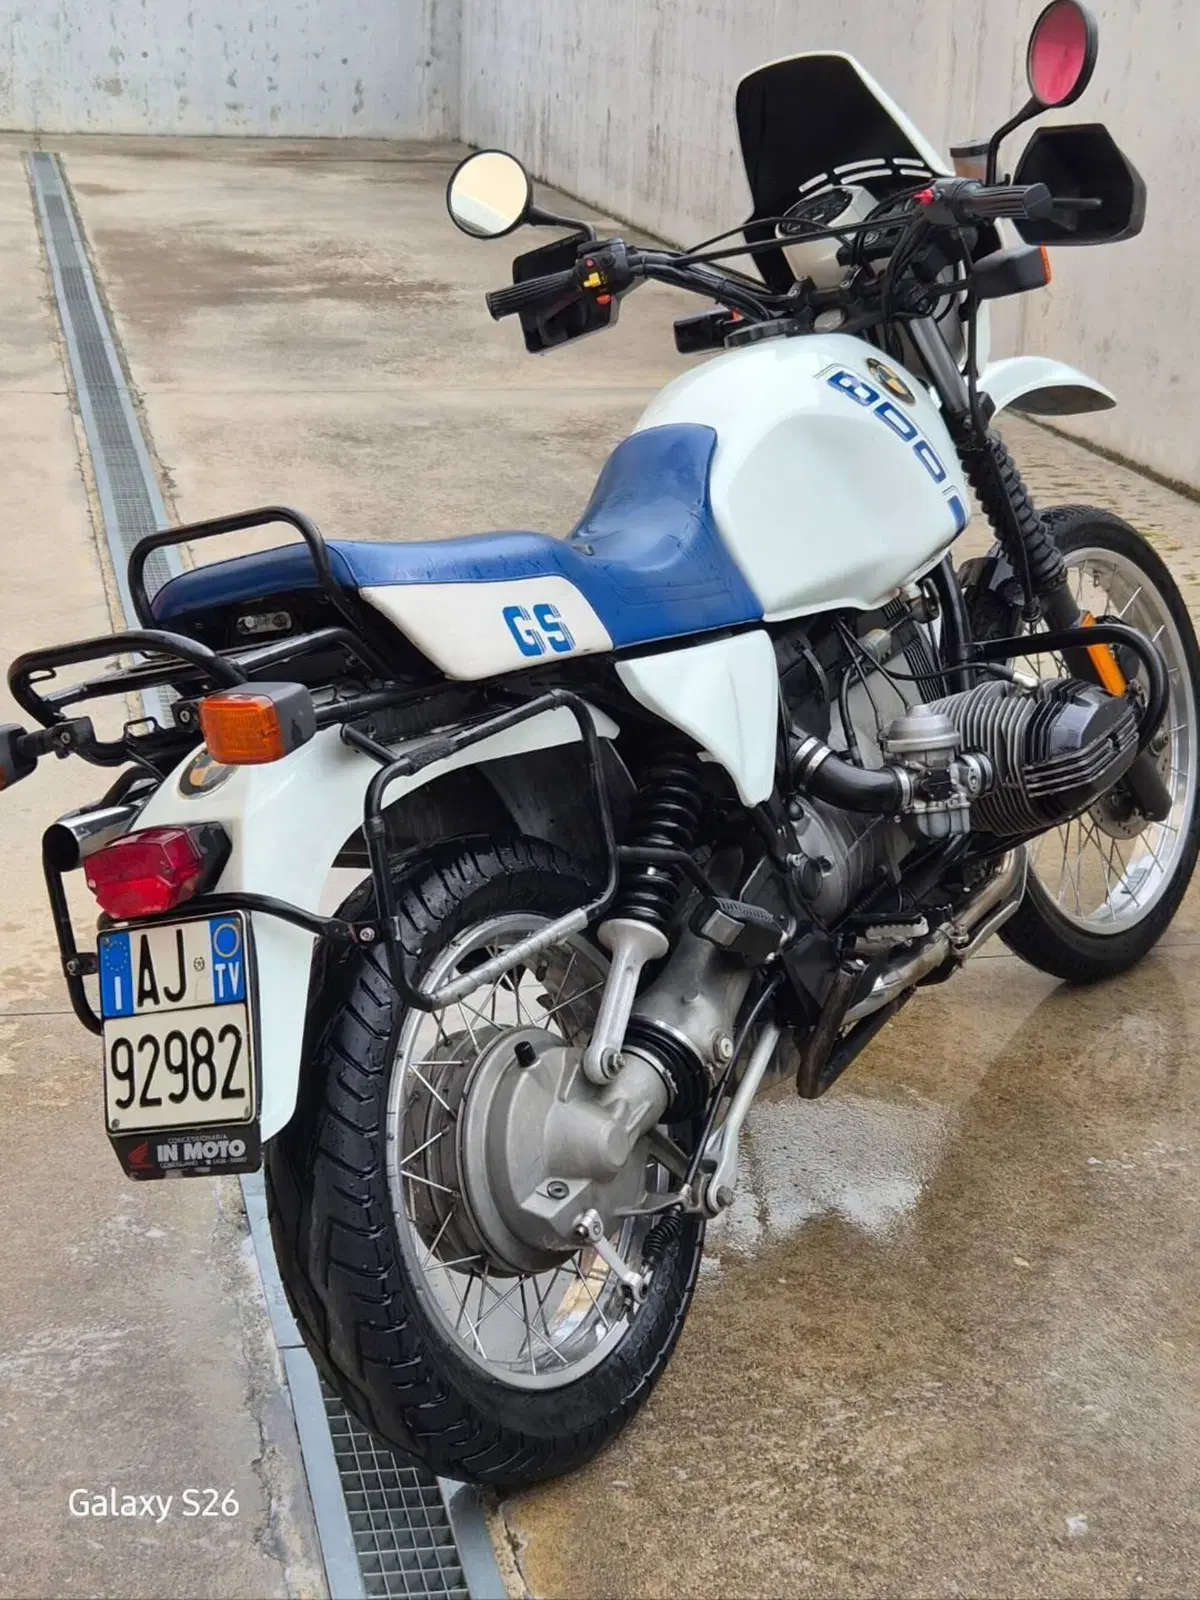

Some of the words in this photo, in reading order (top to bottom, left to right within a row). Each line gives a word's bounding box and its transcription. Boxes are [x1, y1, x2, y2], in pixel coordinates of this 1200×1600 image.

[827, 370, 947, 484] 800
[502, 603, 576, 657] GS
[137, 928, 187, 1007] AJ
[214, 961, 240, 998] TV
[111, 1024, 245, 1109] 92982
[157, 1144, 178, 1162] IN
[184, 1139, 246, 1160] MOTO
[167, 1133, 228, 1144] CONCESSIONARIA
